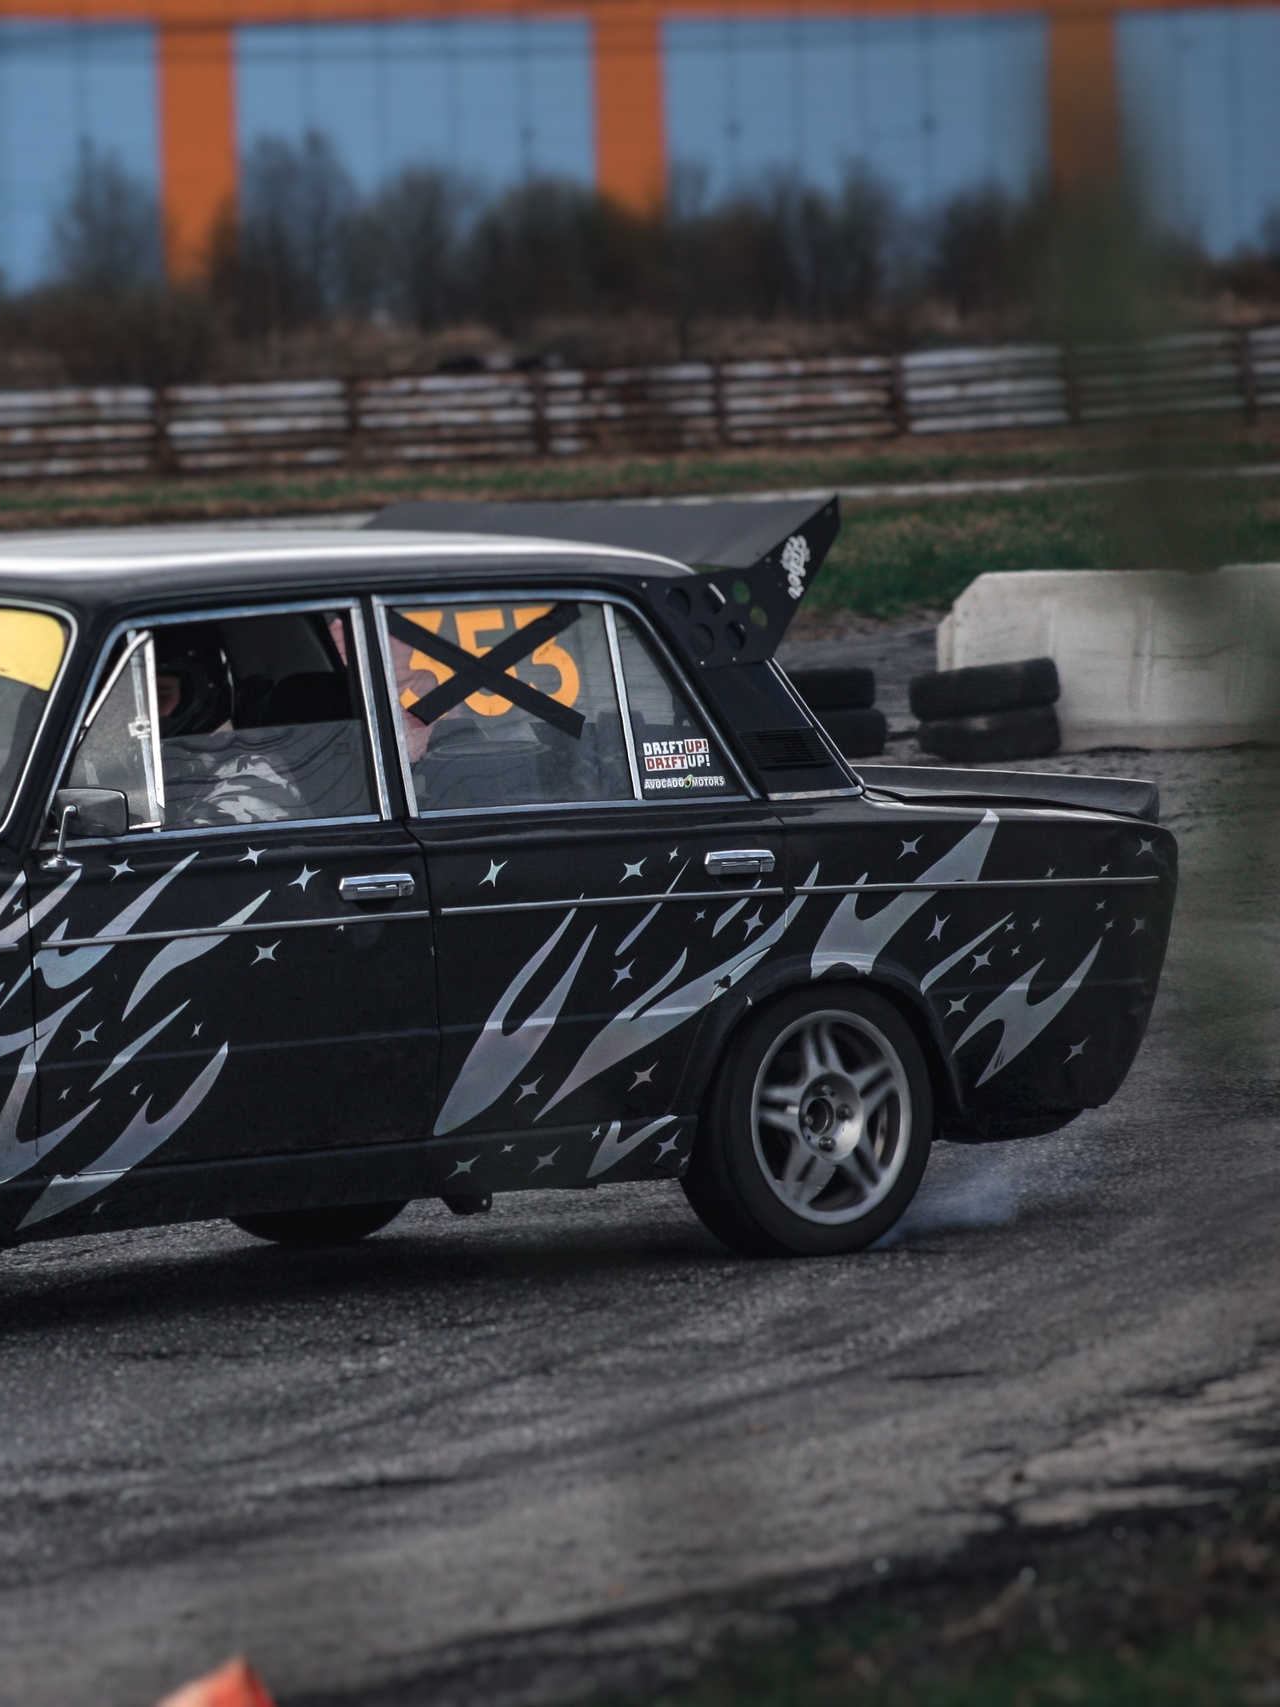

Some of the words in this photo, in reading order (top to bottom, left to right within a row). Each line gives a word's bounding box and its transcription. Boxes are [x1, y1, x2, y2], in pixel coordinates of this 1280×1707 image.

[643, 741, 683, 755] DRIFT
[685, 740, 708, 753] UP!
[646, 756, 686, 770] DRIFT
[687, 754, 710, 767] UP!
[644, 778, 684, 789] AVOCADO
[692, 776, 724, 787] MOTORS
